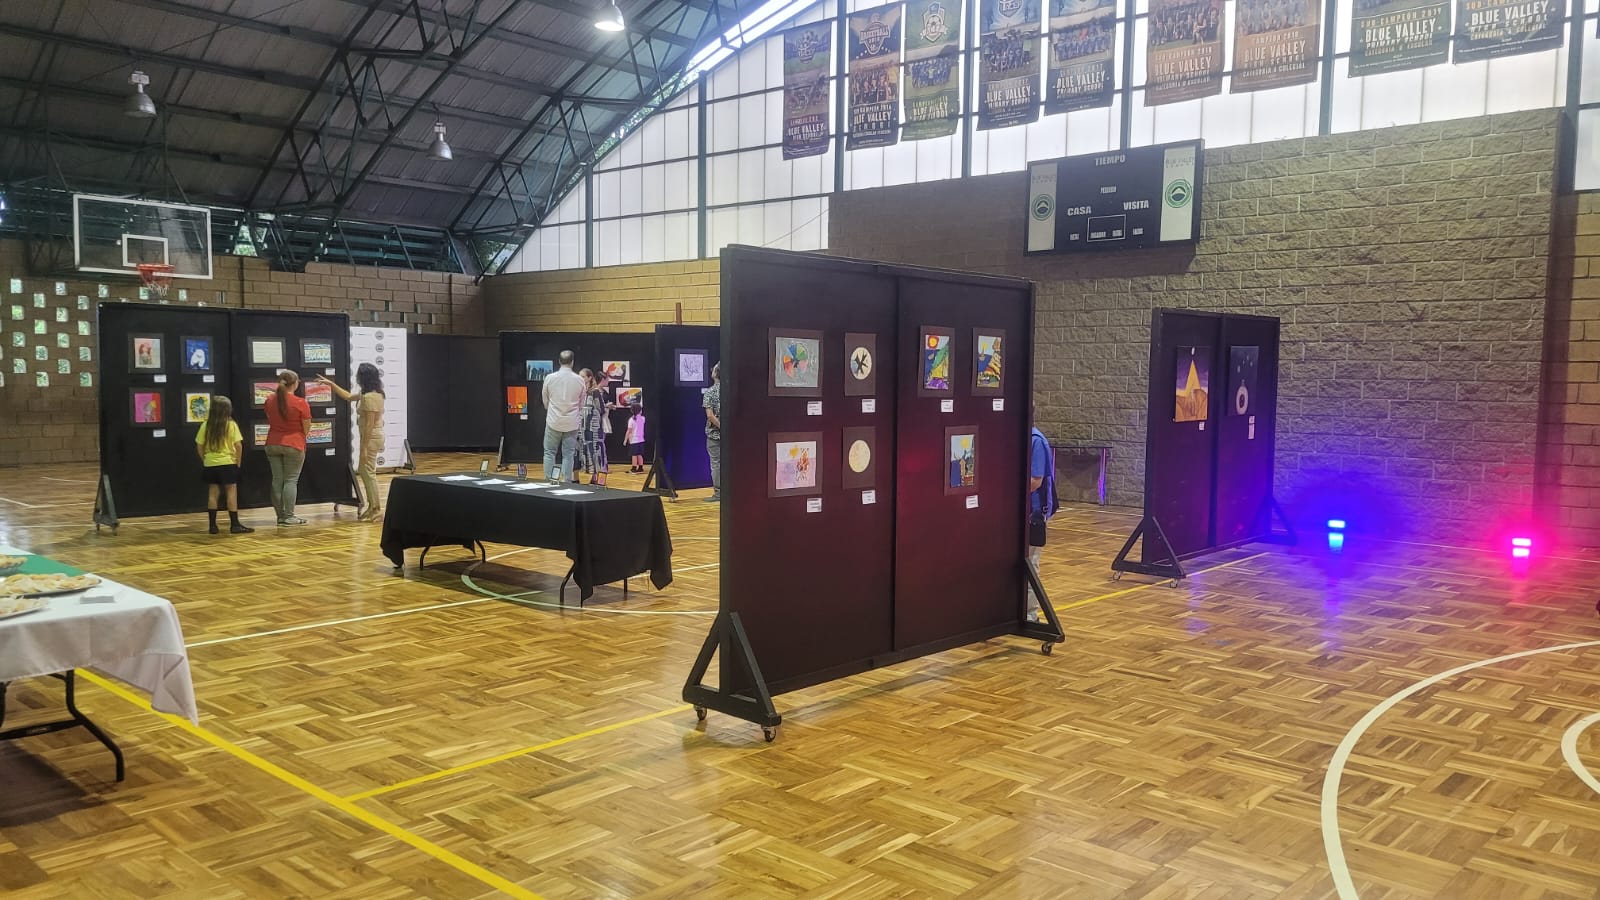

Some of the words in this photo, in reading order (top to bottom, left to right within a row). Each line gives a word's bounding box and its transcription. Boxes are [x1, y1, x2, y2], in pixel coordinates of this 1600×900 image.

[1471, 9, 1500, 26] BLUE
[1504, 0, 1548, 20] VALLEY
[1365, 26, 1391, 43] BLUE
[1395, 18, 1436, 38] VALLEY
[1244, 47, 1266, 63] BLUE
[1270, 39, 1306, 58] VALLEY
[1155, 62, 1175, 76] BLUE
[1179, 55, 1211, 73] VALLEY
[1057, 76, 1073, 89] BLUE
[1077, 70, 1105, 87] VALLEY
[987, 90, 1002, 102] BLUE
[1005, 85, 1031, 100] VALLEY
[867, 110, 891, 122] VALLEY
[802, 122, 825, 133] VALLEY
[1096, 154, 1126, 167] TIEMPO
[1067, 206, 1092, 216] CASA
[1123, 200, 1150, 211] VISITA
